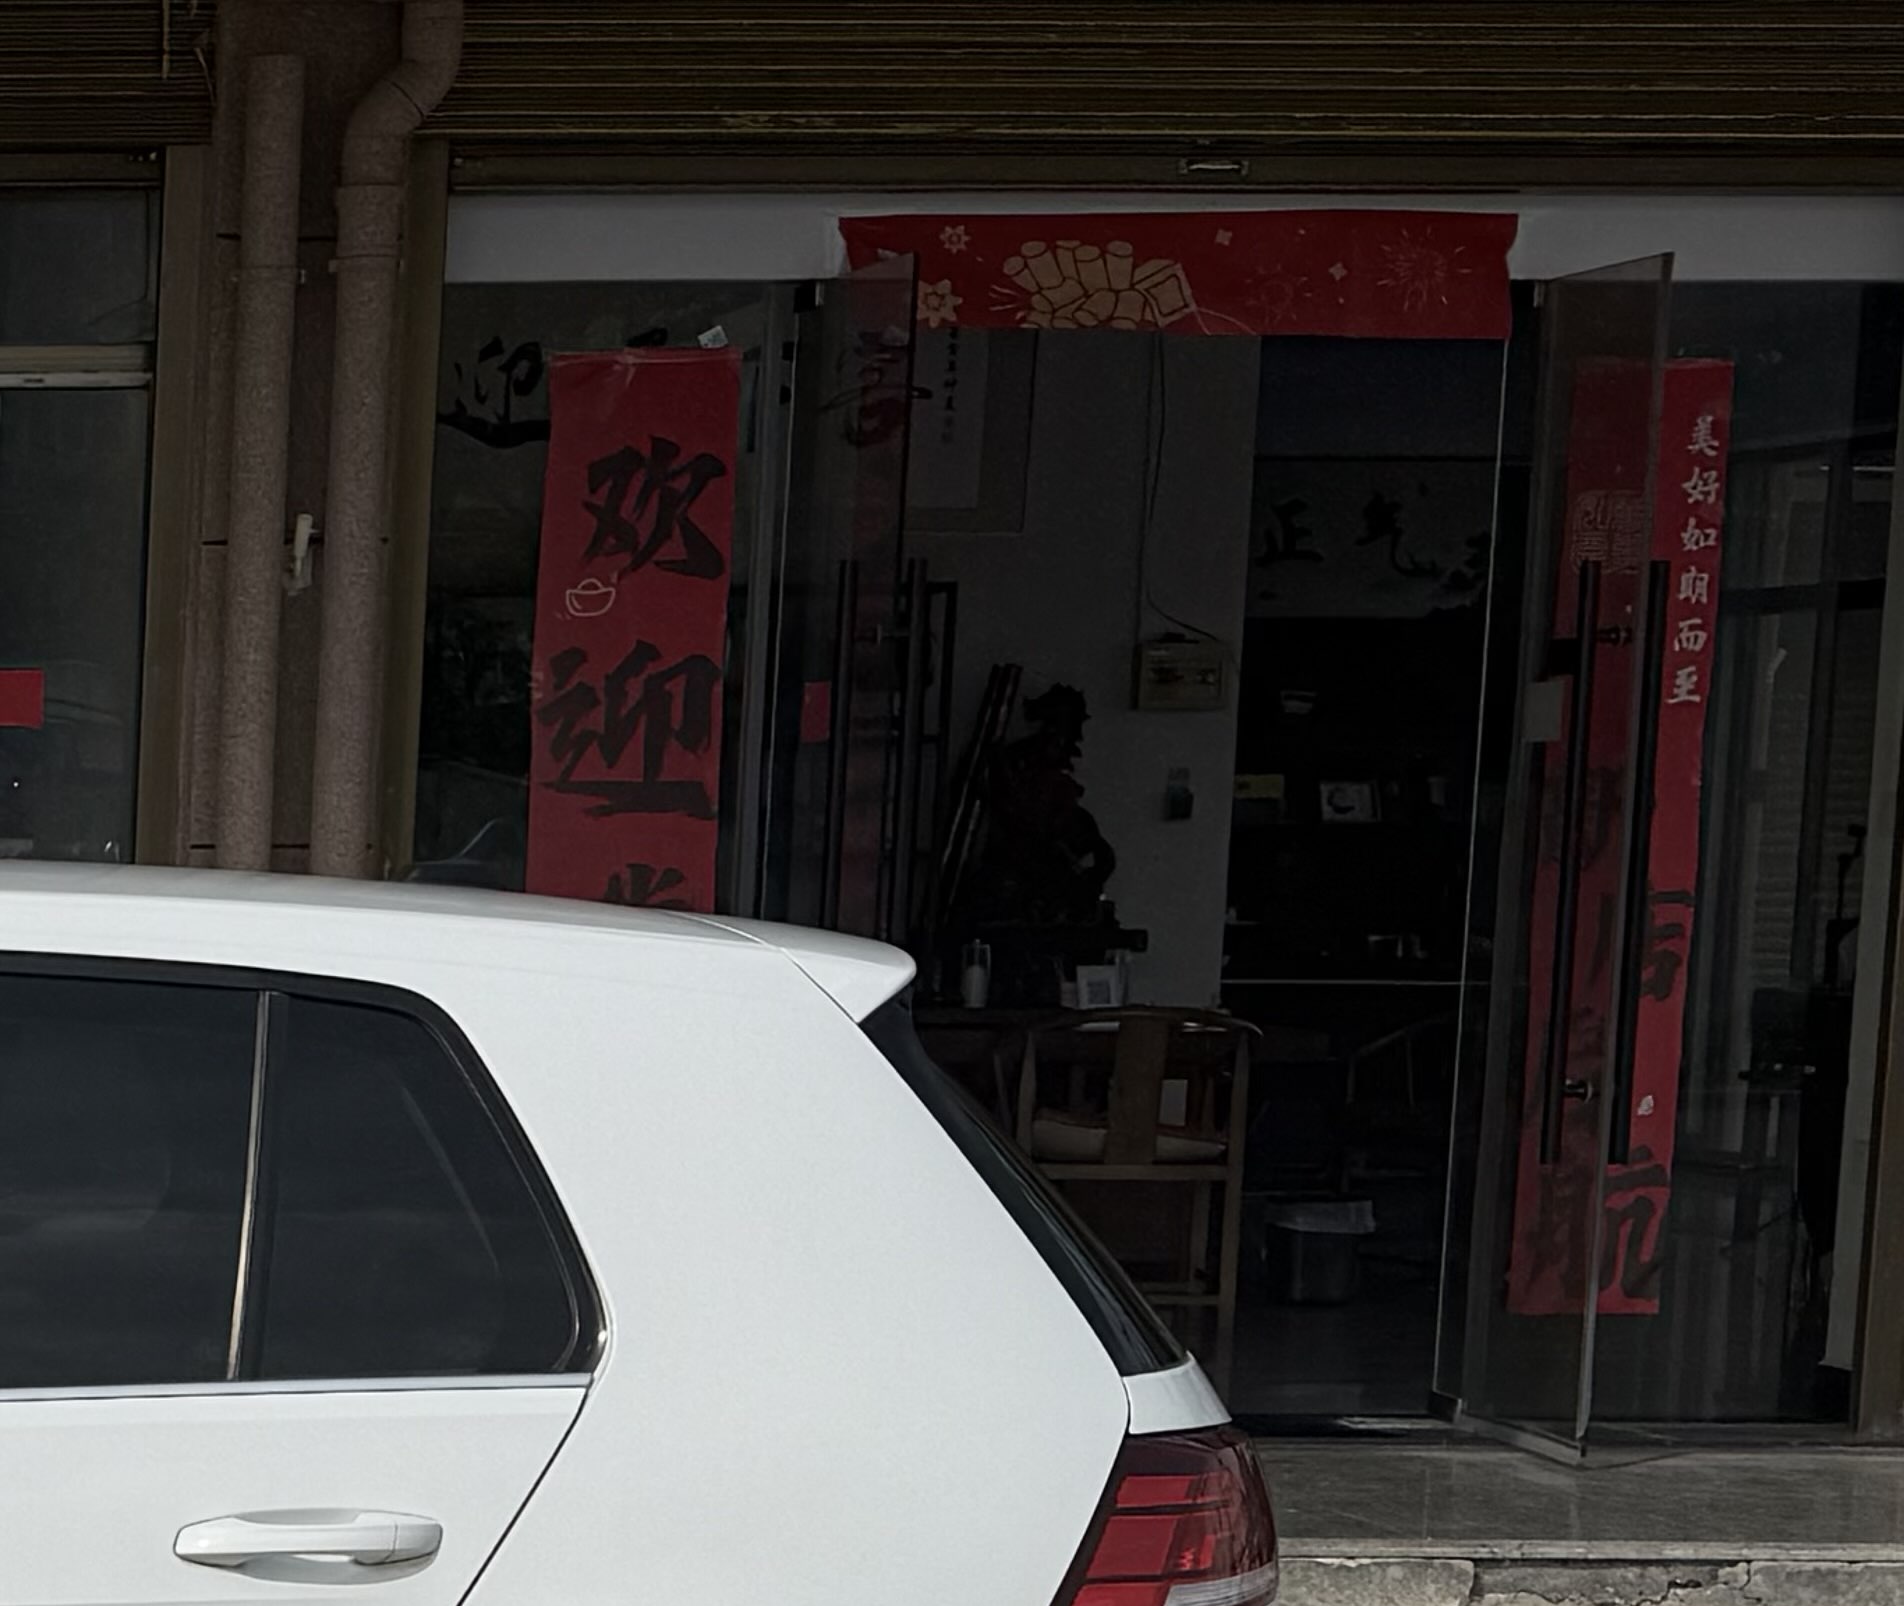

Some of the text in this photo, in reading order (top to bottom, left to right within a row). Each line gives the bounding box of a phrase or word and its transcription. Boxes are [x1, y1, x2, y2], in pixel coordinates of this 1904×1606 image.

[535, 435, 729, 910] 欢迎
[1666, 415, 1721, 706] 美好如期而至
